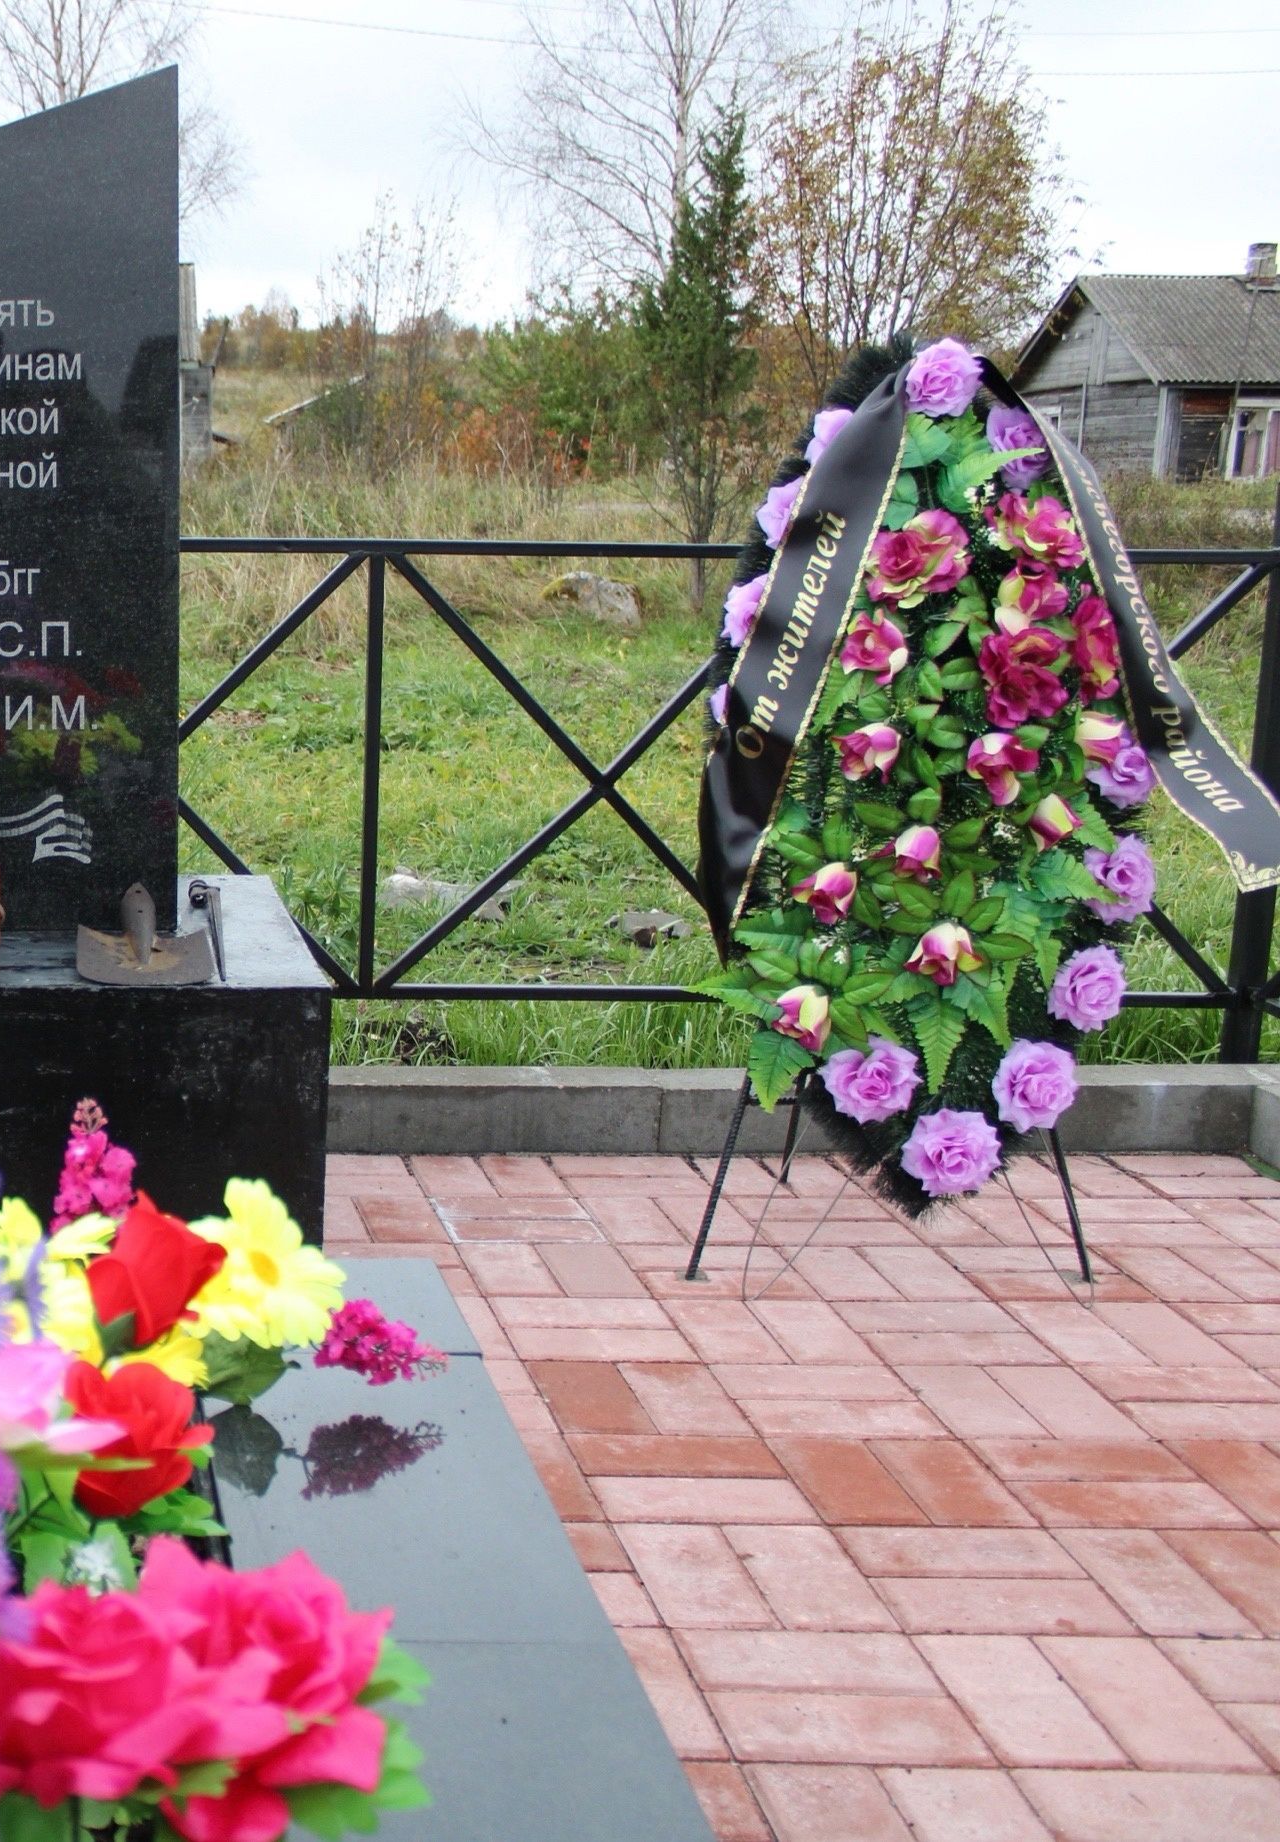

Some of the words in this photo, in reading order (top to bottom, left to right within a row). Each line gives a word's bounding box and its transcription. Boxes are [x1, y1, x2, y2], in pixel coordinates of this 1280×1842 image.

[735, 694, 780, 760] От
[767, 508, 847, 692] жителей
[5, 695, 98, 732] И.М.
[1150, 705, 1246, 815] района
